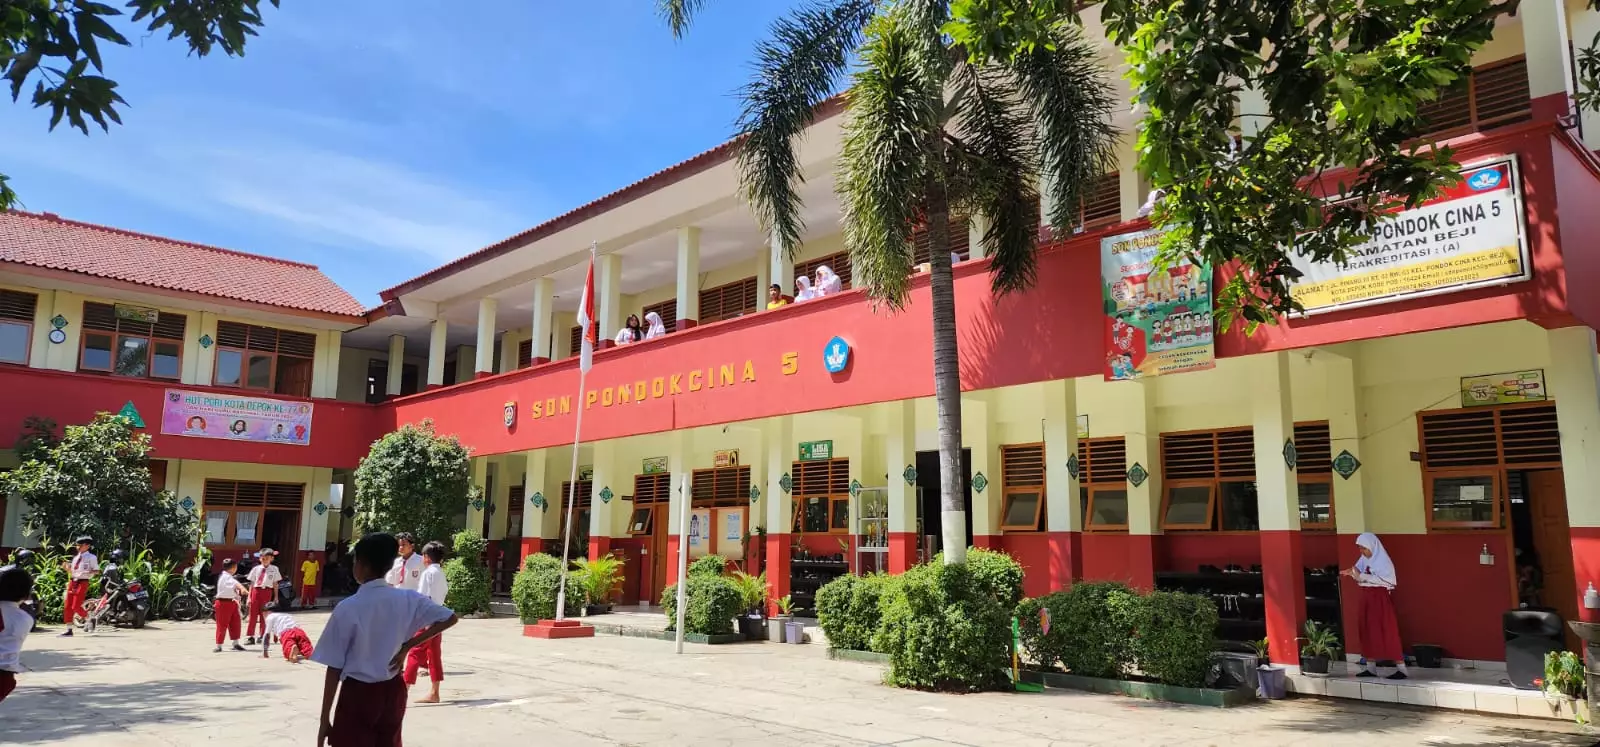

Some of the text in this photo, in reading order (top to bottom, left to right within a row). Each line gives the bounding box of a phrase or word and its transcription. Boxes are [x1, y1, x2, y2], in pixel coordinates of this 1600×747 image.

[1373, 213, 1440, 242] PONDOK
[1445, 204, 1486, 226] CINA
[1491, 200, 1500, 217] 5
[1132, 232, 1165, 249] PONDO
[1319, 237, 1427, 264] KAMATAN
[1434, 226, 1476, 242] BEJI
[1442, 242, 1460, 256] (A)
[1296, 284, 1324, 296] ALAMAT
[1426, 262, 1453, 271] PONDOK
[1455, 258, 1471, 267] CINA
[185, 395, 201, 405] HUT
[224, 399, 245, 409] KOTA
[247, 401, 271, 412] DEPOK
[532, 351, 799, 419] SDN PONDOKCINA 5
